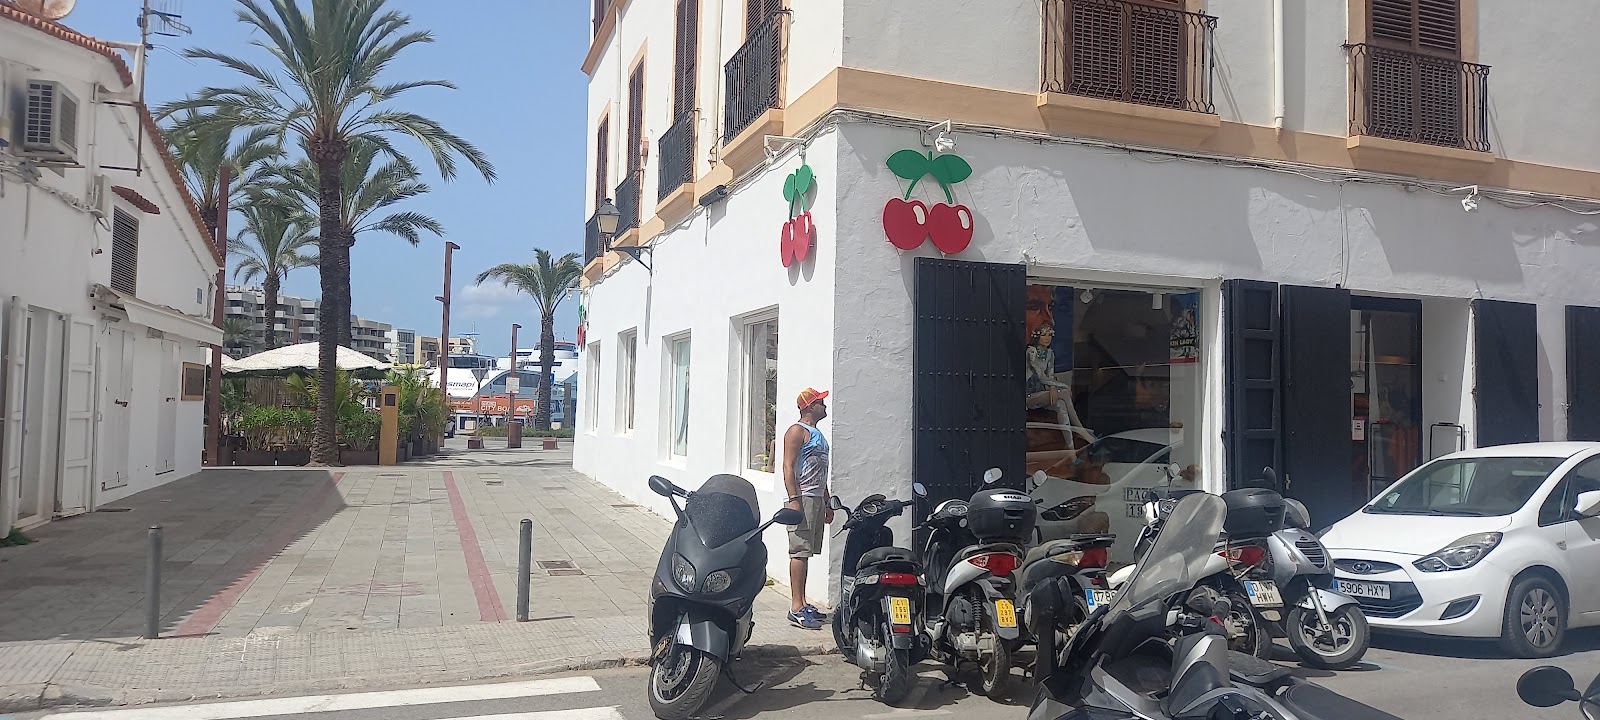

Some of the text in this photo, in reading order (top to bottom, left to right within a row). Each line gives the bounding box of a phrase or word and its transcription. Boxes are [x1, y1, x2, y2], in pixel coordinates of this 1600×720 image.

[435, 381, 475, 389] tsmapi
[1126, 489, 1149, 500] PAC
[1129, 505, 1143, 516] 19
[1340, 582, 1385, 597] 5906 HXY
